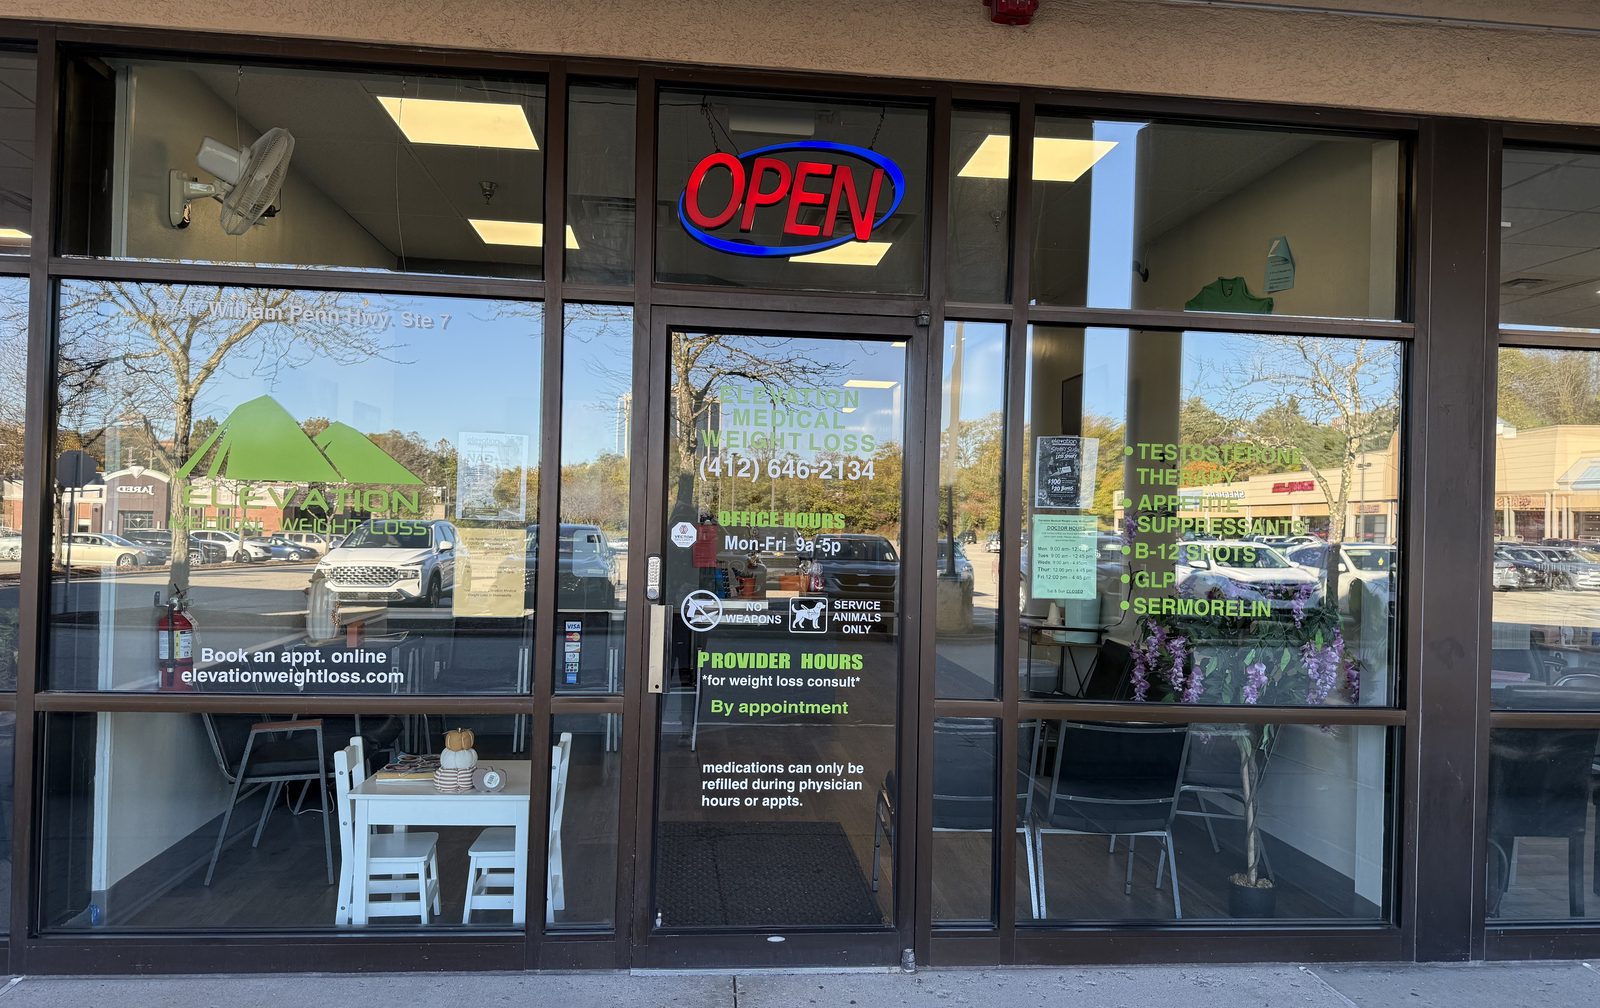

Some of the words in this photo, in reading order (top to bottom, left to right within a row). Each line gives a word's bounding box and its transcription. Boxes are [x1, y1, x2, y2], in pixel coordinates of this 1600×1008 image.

[685, 152, 885, 241] OPEN
[208, 301, 282, 321] William
[291, 306, 340, 324] Penn
[402, 311, 434, 329] Ste
[441, 313, 452, 331] 7
[719, 385, 859, 408] ELEVATION
[733, 408, 846, 430] MEDICAL
[702, 430, 803, 450] WEIGHT
[809, 433, 876, 453] LOSS
[1137, 443, 1303, 465] TESTOSTERONE
[699, 456, 760, 483] (412)
[767, 458, 876, 481] 646-2134
[1136, 468, 1237, 487] THERAPY
[182, 485, 420, 514] ELEVATION
[1137, 494, 1239, 513] APPETITE
[169, 516, 264, 532] MEDICAL
[278, 518, 363, 535] WEIGHT
[369, 519, 427, 536] LOSS
[718, 511, 779, 527] OFFICE
[783, 512, 846, 529] HOURS
[1137, 516, 1306, 536] SUPPRESSANTS
[724, 535, 786, 551] Mon-Fri
[796, 536, 841, 553] 9a-5p
[1135, 543, 1179, 560] B-12
[1187, 545, 1256, 563] SHOTS
[1135, 571, 1175, 588] GLP
[745, 601, 762, 612] NO
[833, 600, 881, 611] SERVICE
[1133, 597, 1271, 618] SERMORELIN
[725, 614, 782, 625] WEAPONS
[832, 612, 881, 623] ANIMALS
[842, 624, 872, 635] ONLY
[201, 648, 248, 663] Book
[253, 650, 276, 663] an
[280, 650, 326, 666] appt.
[331, 649, 387, 663] online
[698, 651, 791, 669] PROVIDER
[800, 653, 864, 670] HOURS
[181, 668, 405, 686] elevationweightloss.com
[729, 675, 773, 690] weight
[776, 675, 804, 687] loss
[710, 700, 734, 716] By
[738, 700, 849, 717] appointment
[702, 762, 784, 774] medications
[787, 764, 812, 774] can
[815, 762, 844, 777] only
[847, 763, 864, 774] be
[701, 778, 748, 790] refilled
[751, 778, 796, 793] during
[799, 778, 863, 793] physician
[701, 795, 741, 807] hours
[744, 797, 759, 807] or
[762, 795, 803, 810] appts.
